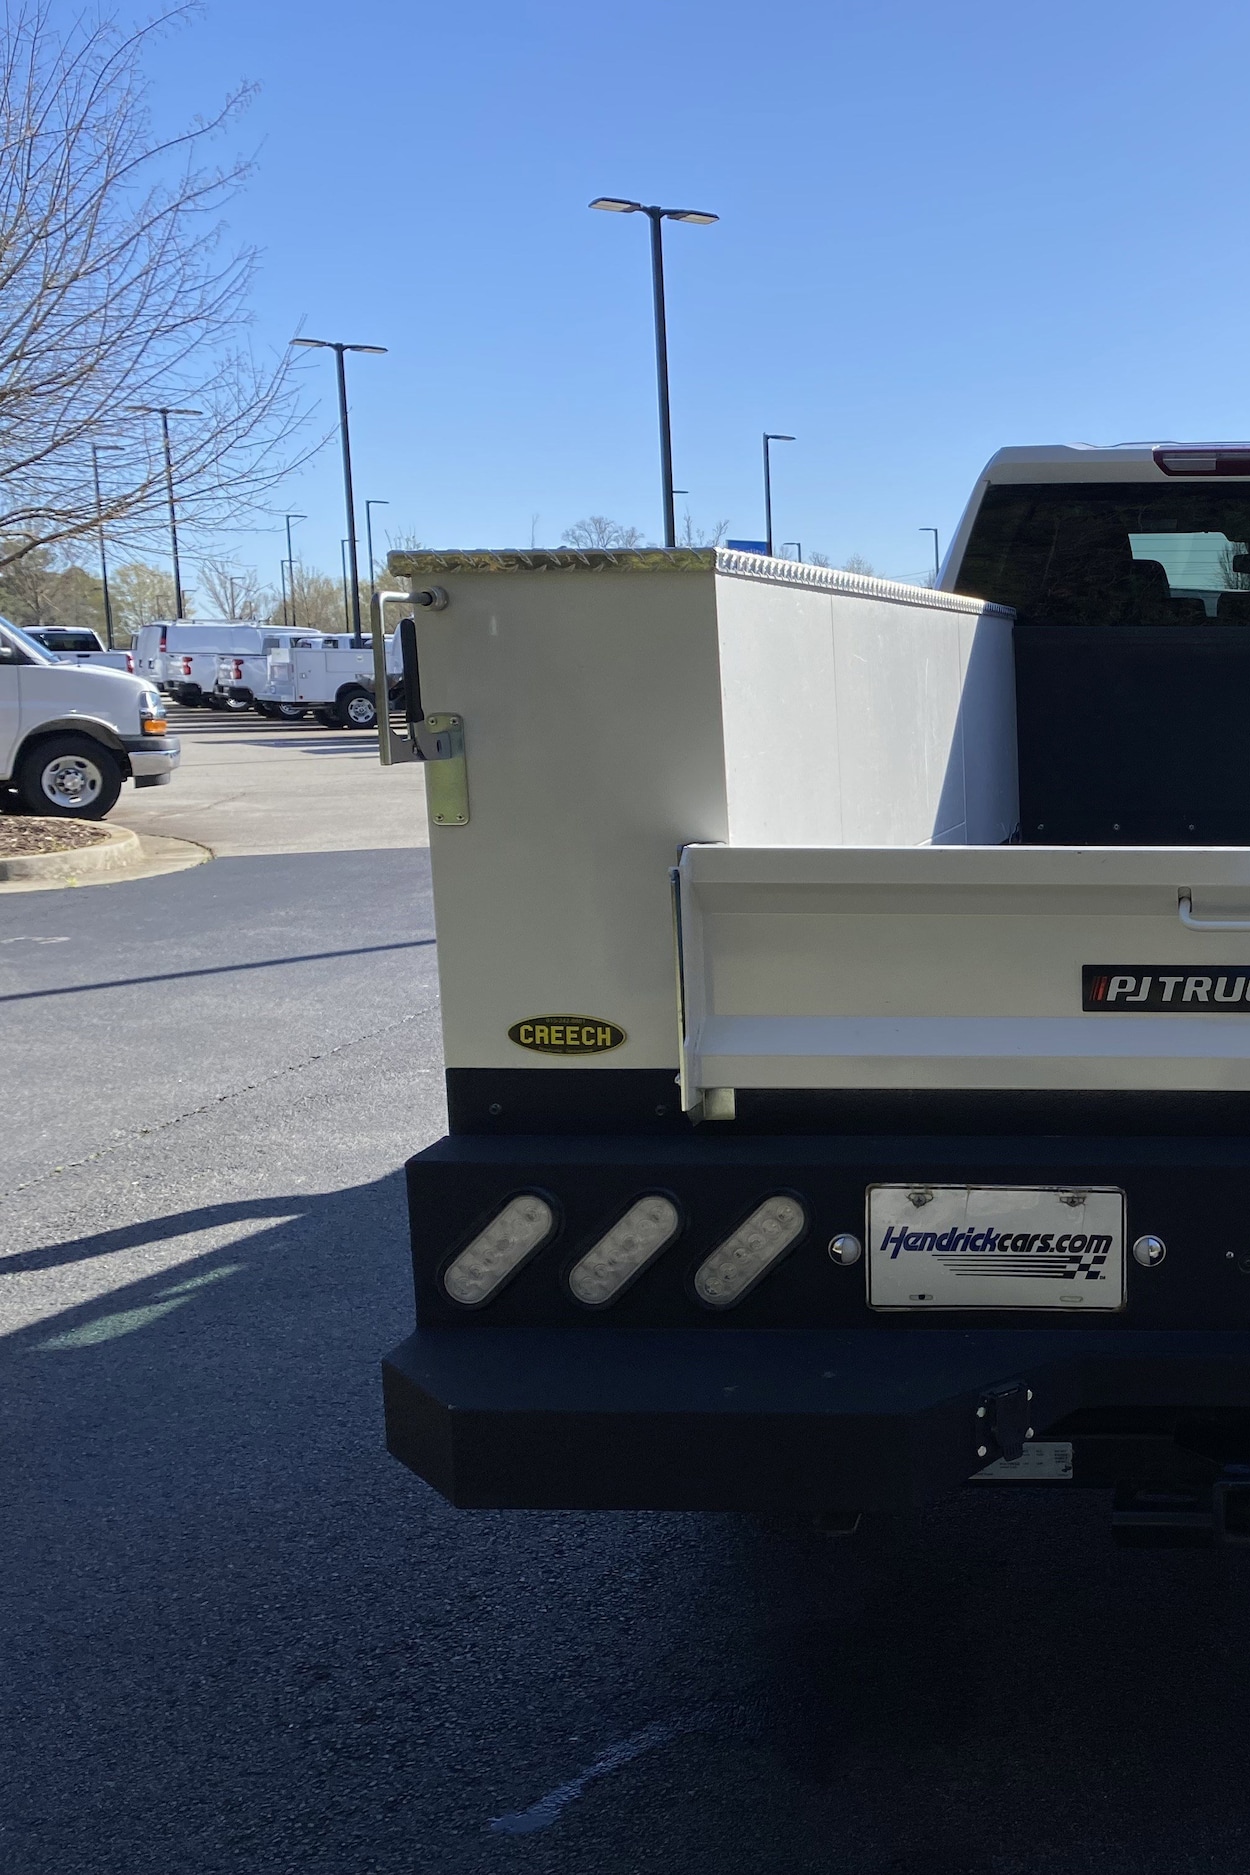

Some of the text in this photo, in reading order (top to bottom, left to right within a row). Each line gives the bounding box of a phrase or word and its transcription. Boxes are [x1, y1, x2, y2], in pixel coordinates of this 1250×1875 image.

[1107, 976, 1151, 1002] PJ
[519, 1024, 612, 1046] CREECH
[880, 1226, 1113, 1260] Hendrickcars.com
